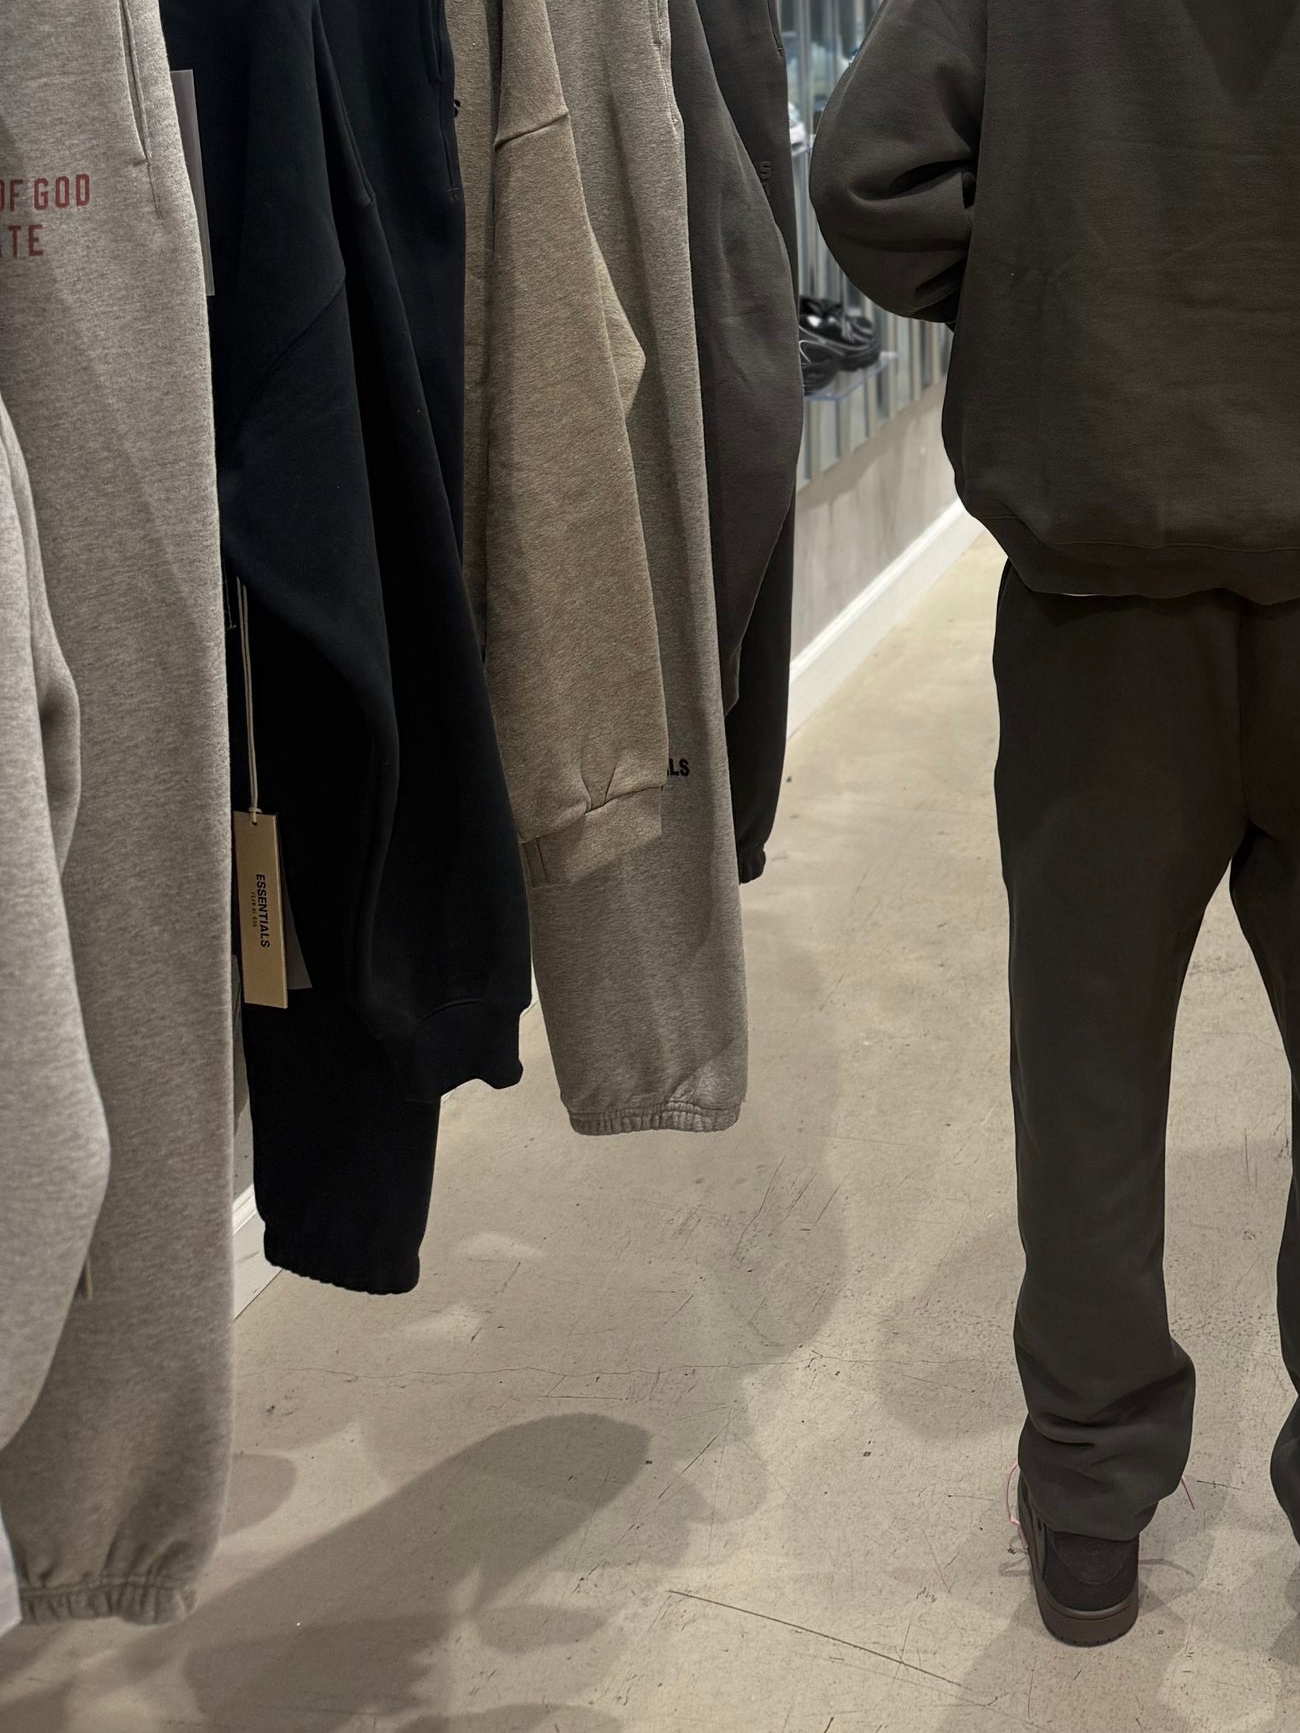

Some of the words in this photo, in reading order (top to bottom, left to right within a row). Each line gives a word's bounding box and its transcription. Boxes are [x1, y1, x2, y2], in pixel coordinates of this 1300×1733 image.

[33, 173, 90, 211] GOD
[0, 224, 44, 259] TE
[666, 758, 690, 777] LS
[256, 874, 270, 947] ESSENTIALS
